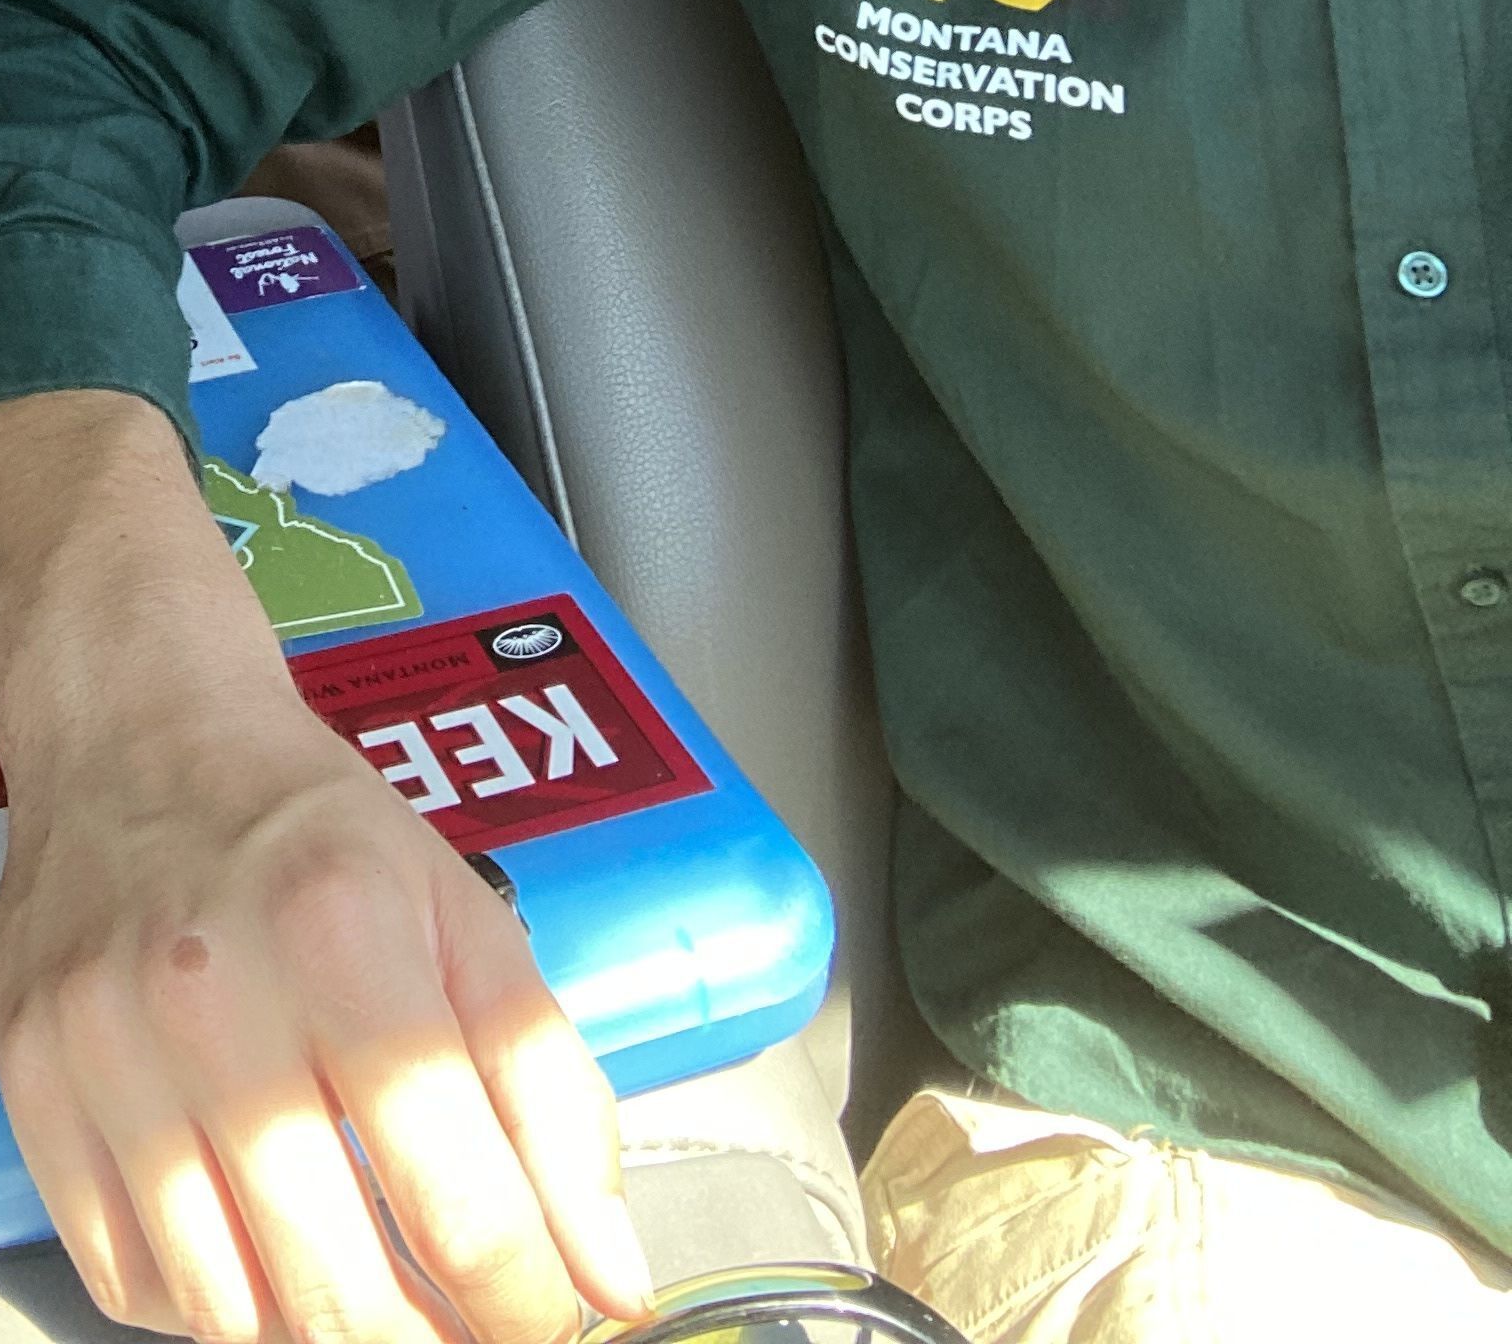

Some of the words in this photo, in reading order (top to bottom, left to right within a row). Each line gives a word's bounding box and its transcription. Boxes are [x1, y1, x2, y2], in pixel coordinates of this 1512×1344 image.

[856, 1, 1073, 64] MONTANA
[815, 24, 1126, 114] CONSERVATION
[895, 92, 1033, 141] CORPS
[229, 251, 319, 280] National
[235, 243, 300, 265] Forest
[351, 651, 471, 691] MONTANA
